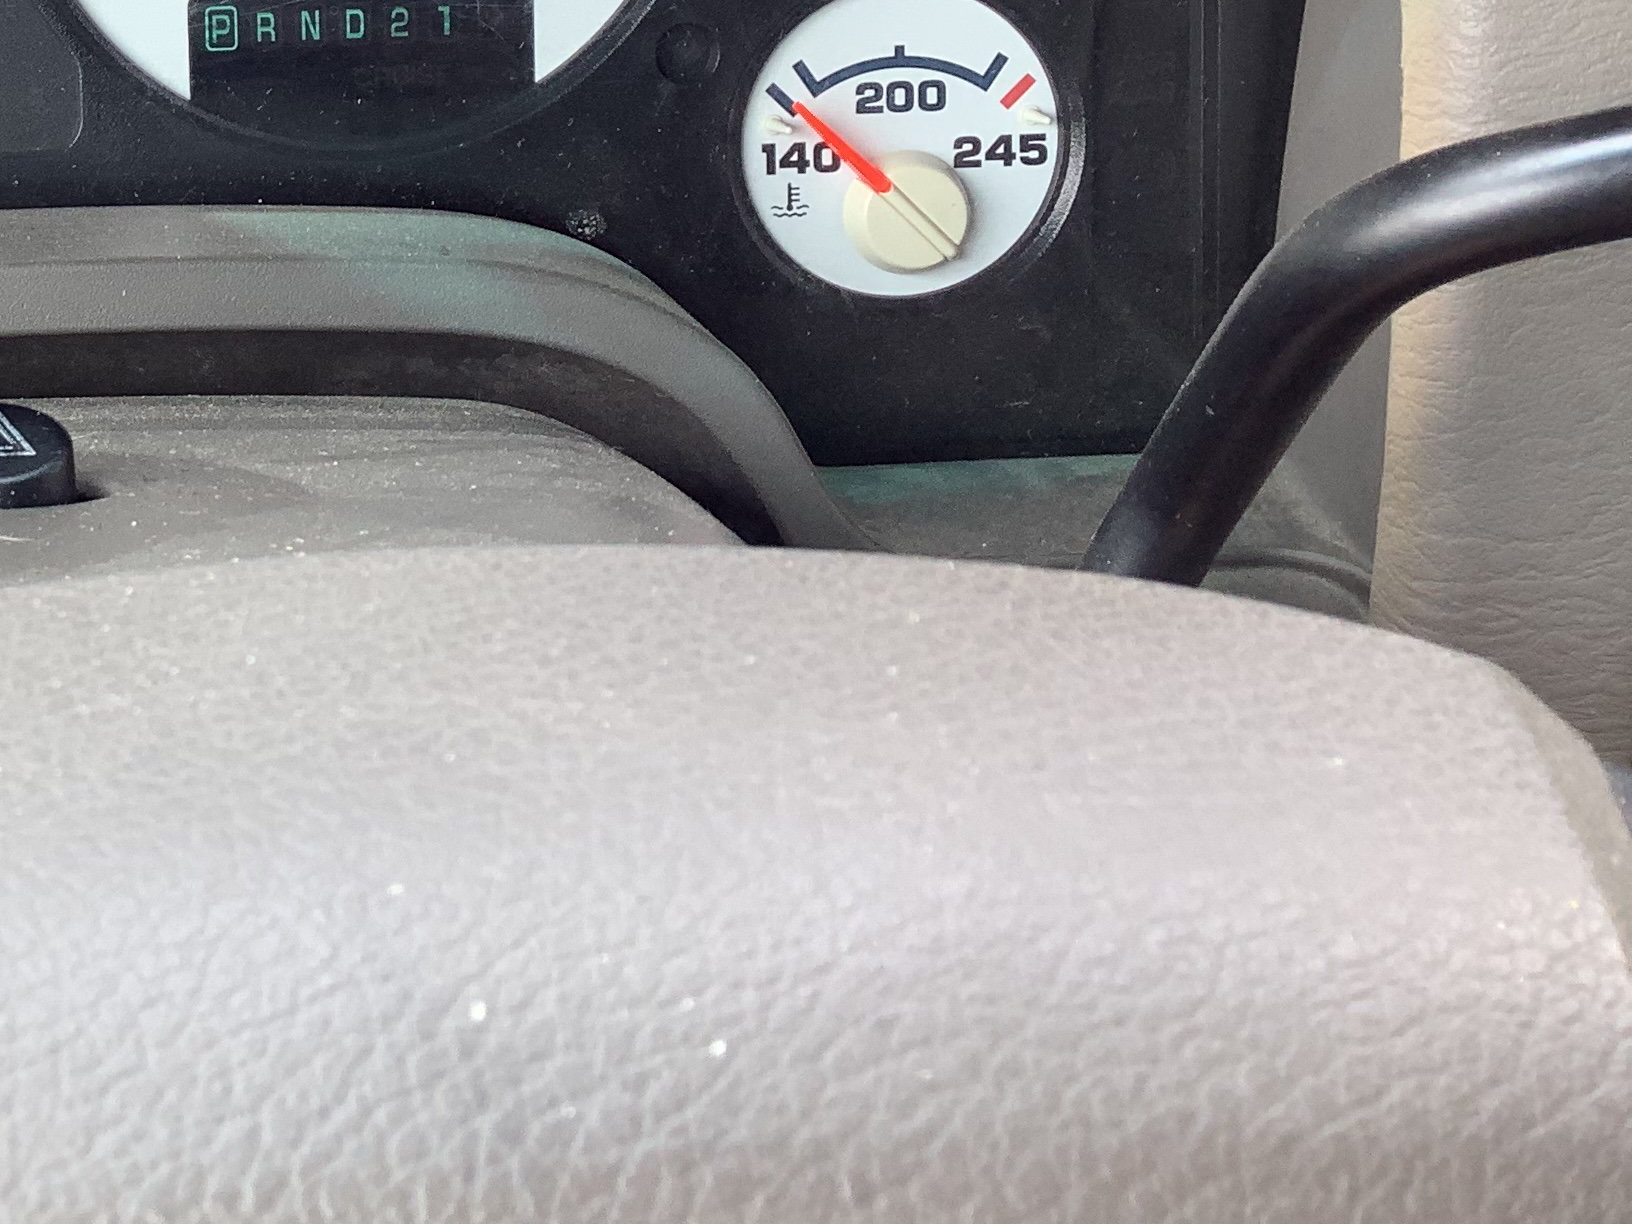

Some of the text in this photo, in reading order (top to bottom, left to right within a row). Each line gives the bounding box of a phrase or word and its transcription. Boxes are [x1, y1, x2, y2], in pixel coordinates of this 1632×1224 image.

[211, 5, 451, 44] P R N D 2 1
[855, 79, 947, 115] 200
[761, 141, 841, 176] 140
[952, 133, 1048, 169] 245
